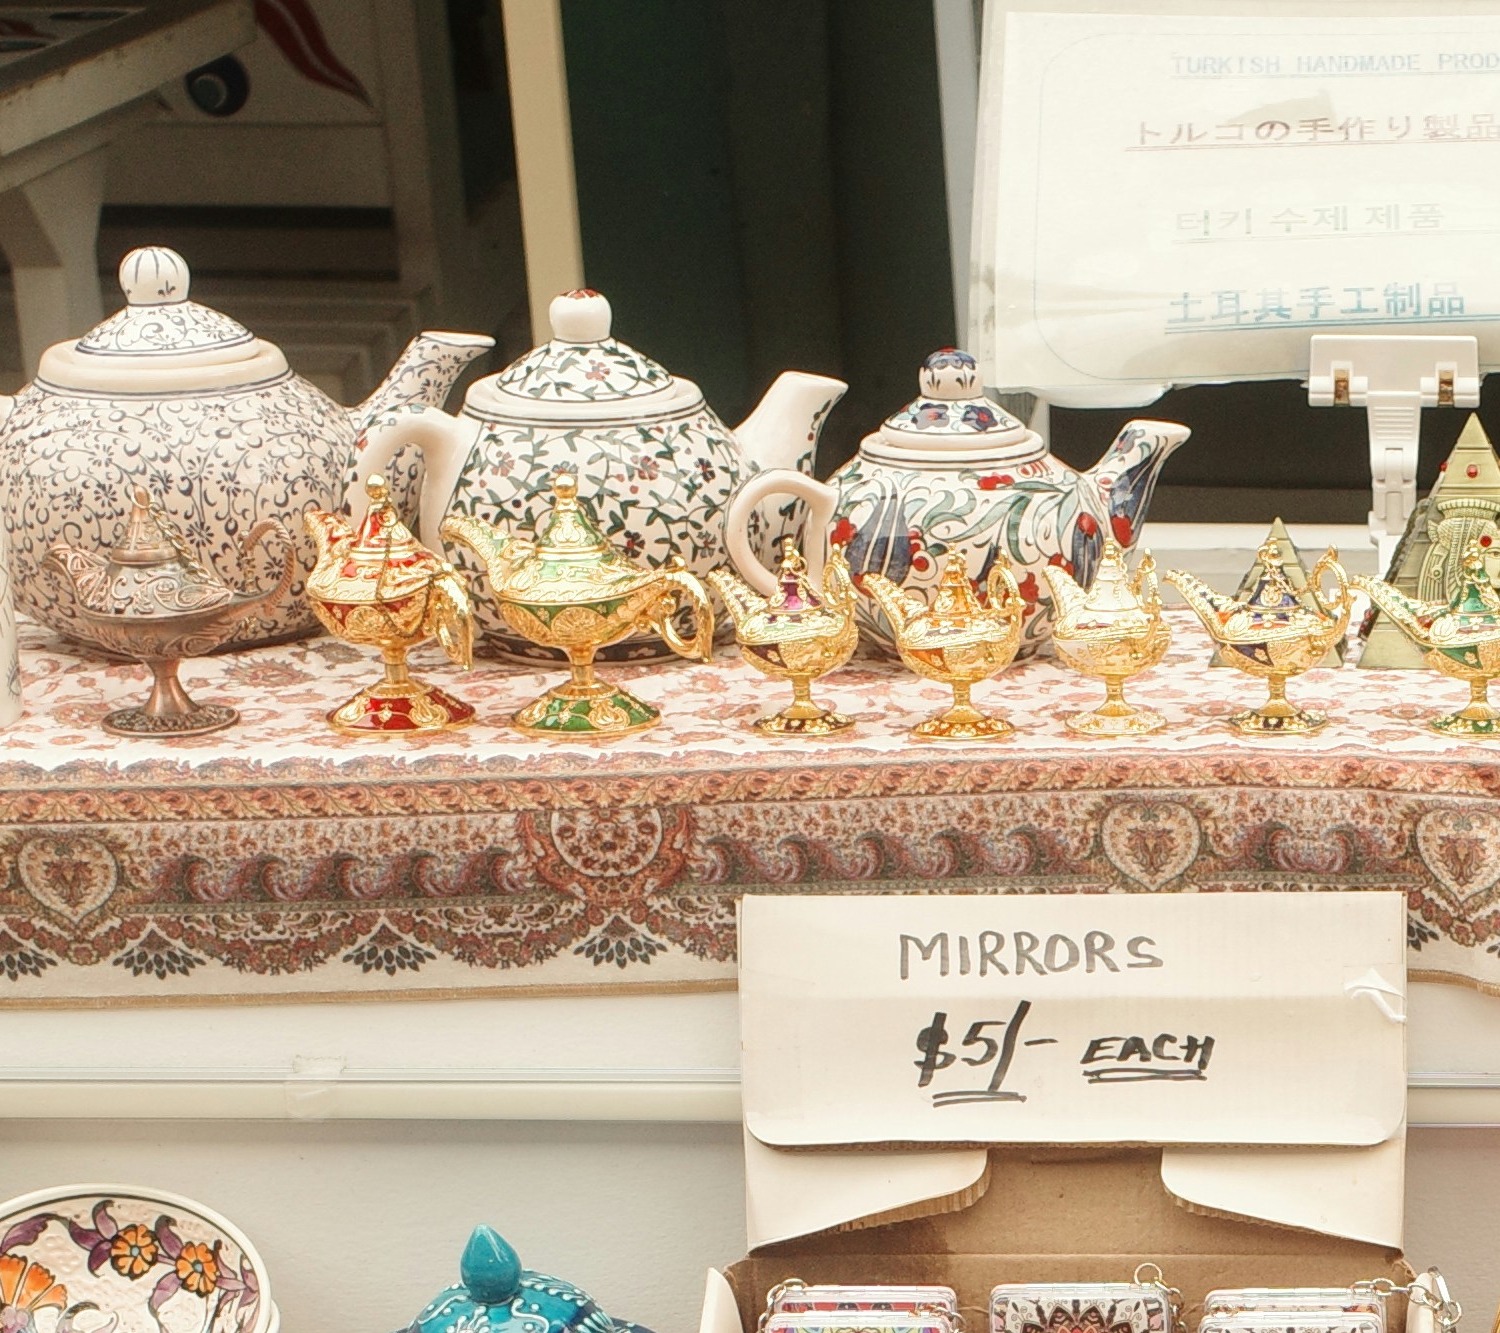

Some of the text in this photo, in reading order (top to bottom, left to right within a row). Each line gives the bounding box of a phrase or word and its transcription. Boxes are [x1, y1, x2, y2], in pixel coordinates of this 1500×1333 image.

[1171, 55, 1281, 75] TURKISH
[1297, 53, 1421, 73] HANDMADE
[1176, 208, 1254, 236] 터키
[1269, 204, 1349, 233] 수제
[1365, 203, 1445, 231] 제품
[1168, 281, 1466, 324] 土耳其手工制品
[900, 930, 1164, 981] MIRRORS
[914, 1000, 1216, 1092] $5/- EACH
